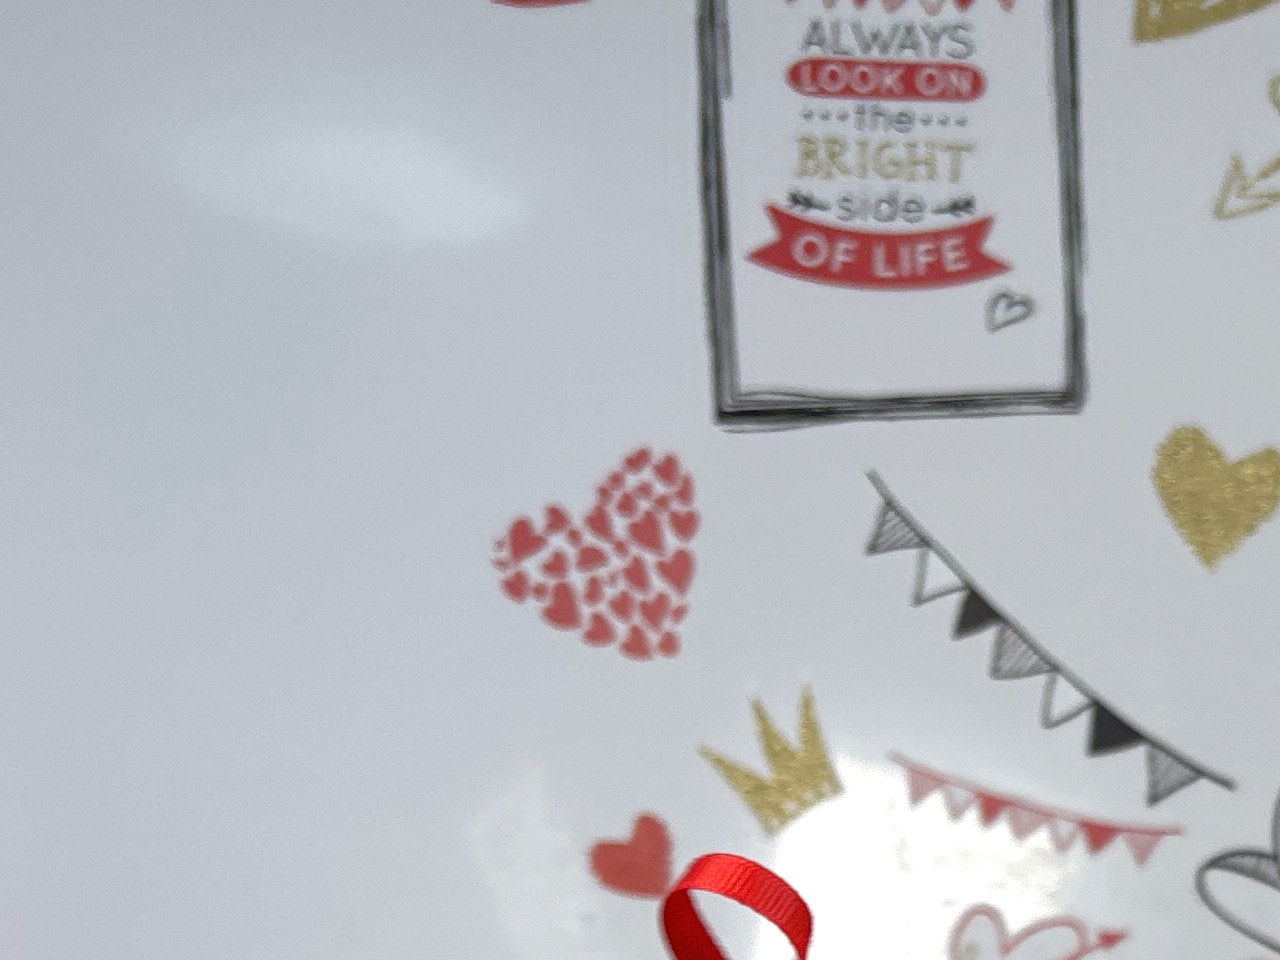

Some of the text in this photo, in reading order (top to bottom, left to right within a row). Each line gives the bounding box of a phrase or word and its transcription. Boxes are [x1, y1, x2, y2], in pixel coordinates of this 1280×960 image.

[801, 17, 977, 59] ALWAYS
[801, 63, 974, 97] LOOK ON
[854, 103, 914, 133] the
[795, 133, 976, 184] BRIGHT
[836, 190, 926, 223] side
[791, 234, 969, 278] OF LIFE
